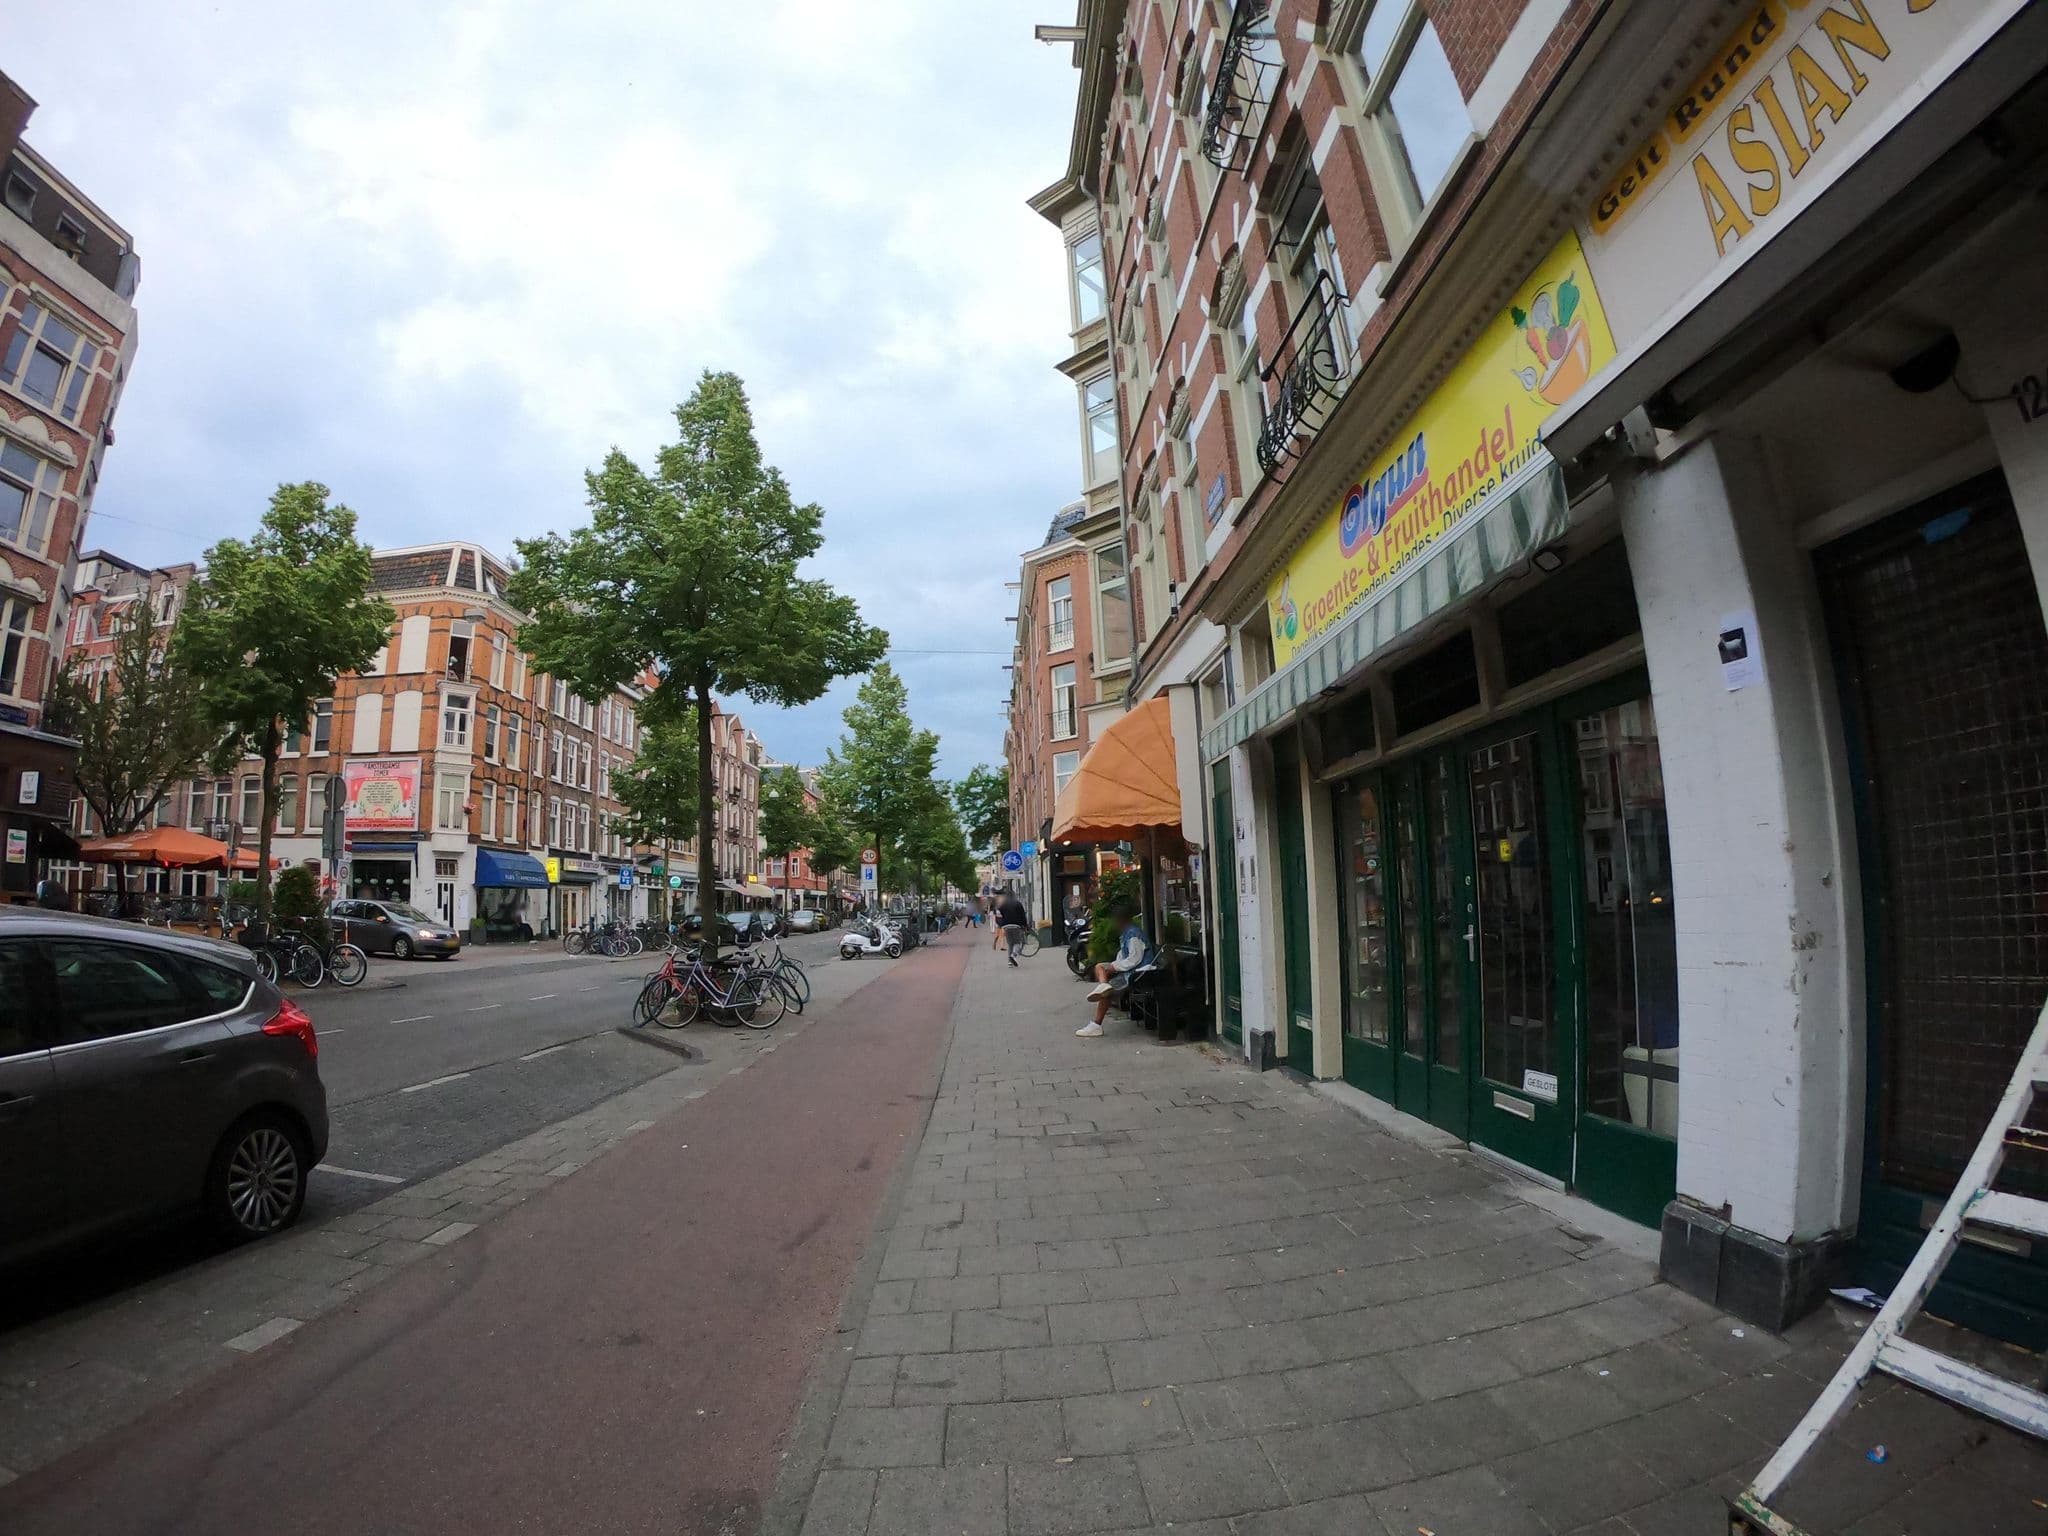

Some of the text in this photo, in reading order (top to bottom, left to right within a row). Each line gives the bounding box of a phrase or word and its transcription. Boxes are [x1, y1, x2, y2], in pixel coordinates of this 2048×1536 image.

[1597, 8, 1776, 221] Geit Rund
[1692, 0, 1891, 257] ASIAN
[1303, 403, 1515, 633] Groente- & Fruithandel
[1341, 431, 1426, 548] Olgun
[1443, 477, 1496, 531] Diverse
[863, 852, 875, 860] 30
